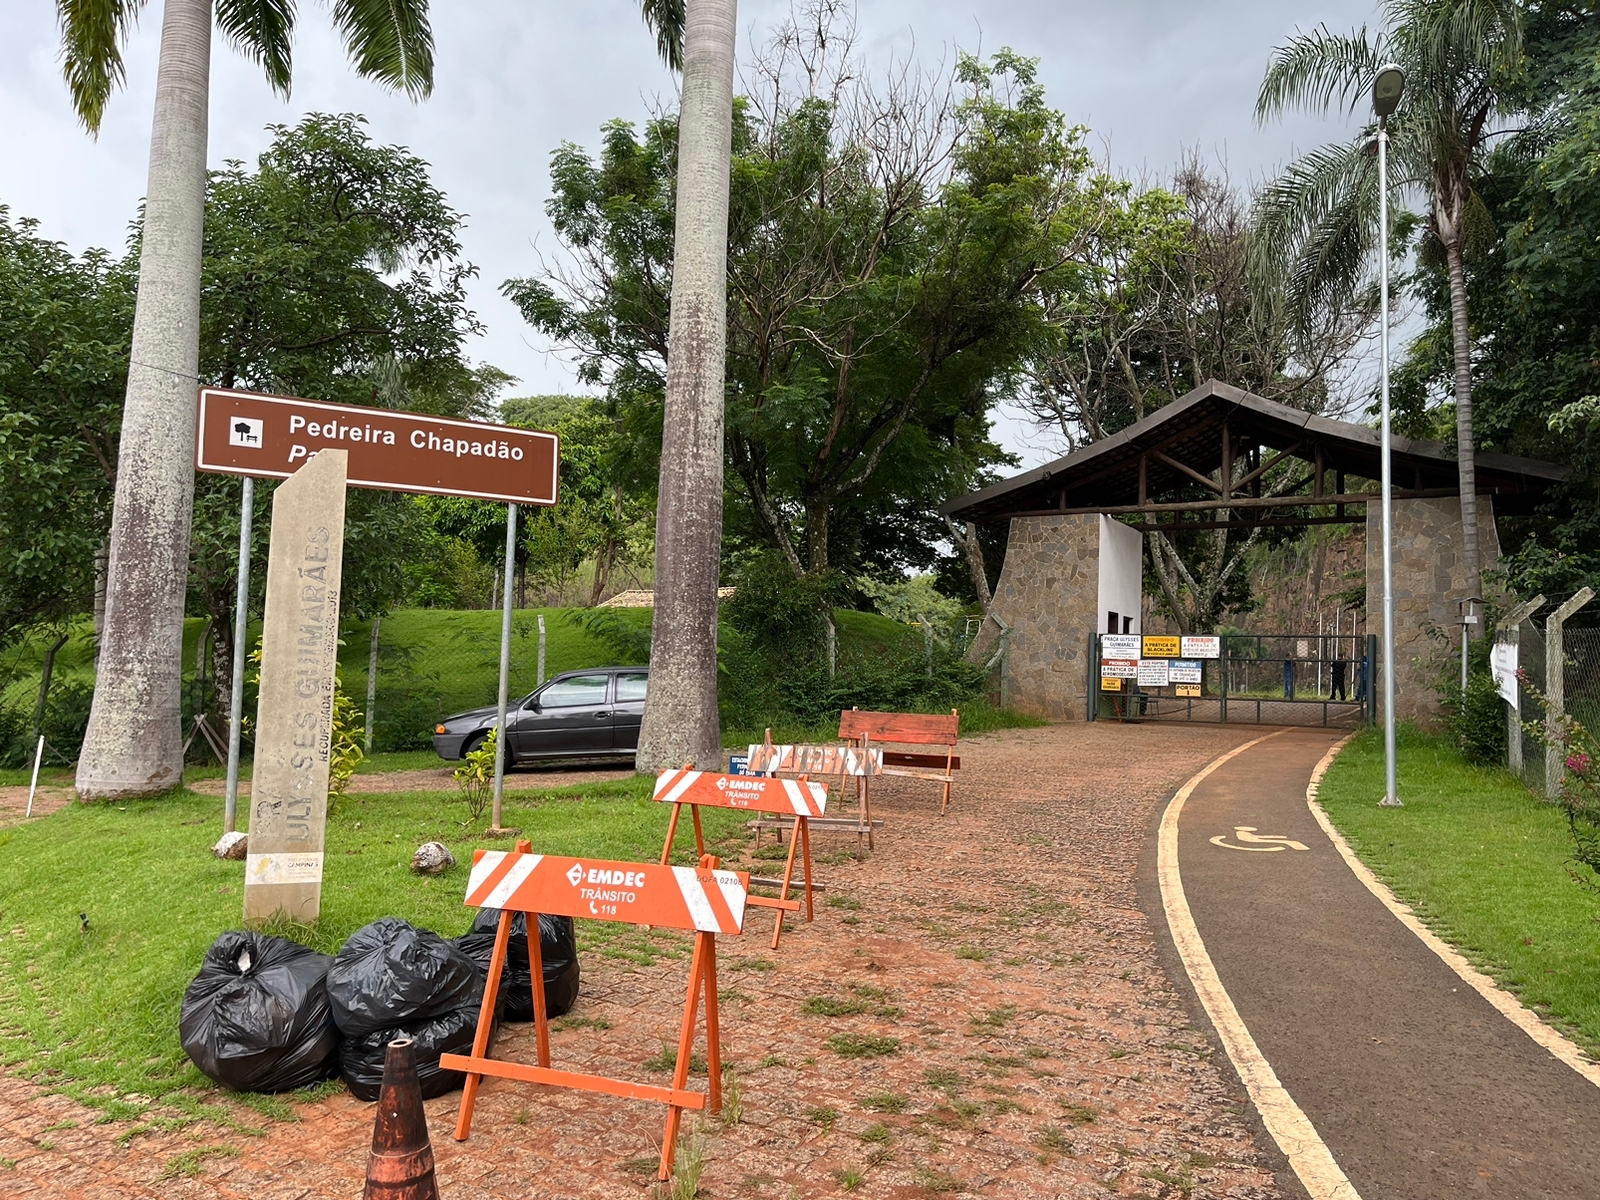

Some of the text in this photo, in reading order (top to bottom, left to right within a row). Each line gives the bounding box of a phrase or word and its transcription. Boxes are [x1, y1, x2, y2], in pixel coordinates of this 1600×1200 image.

[289, 414, 524, 462] Pedreira Chapadão
[284, 712, 318, 841] ULYSSES
[729, 780, 766, 791] EMDEC
[724, 791, 760, 800] TRÂNSITO
[587, 868, 645, 888] EMDEC
[580, 887, 636, 904] TRÂNSITO
[601, 904, 617, 915] 118
